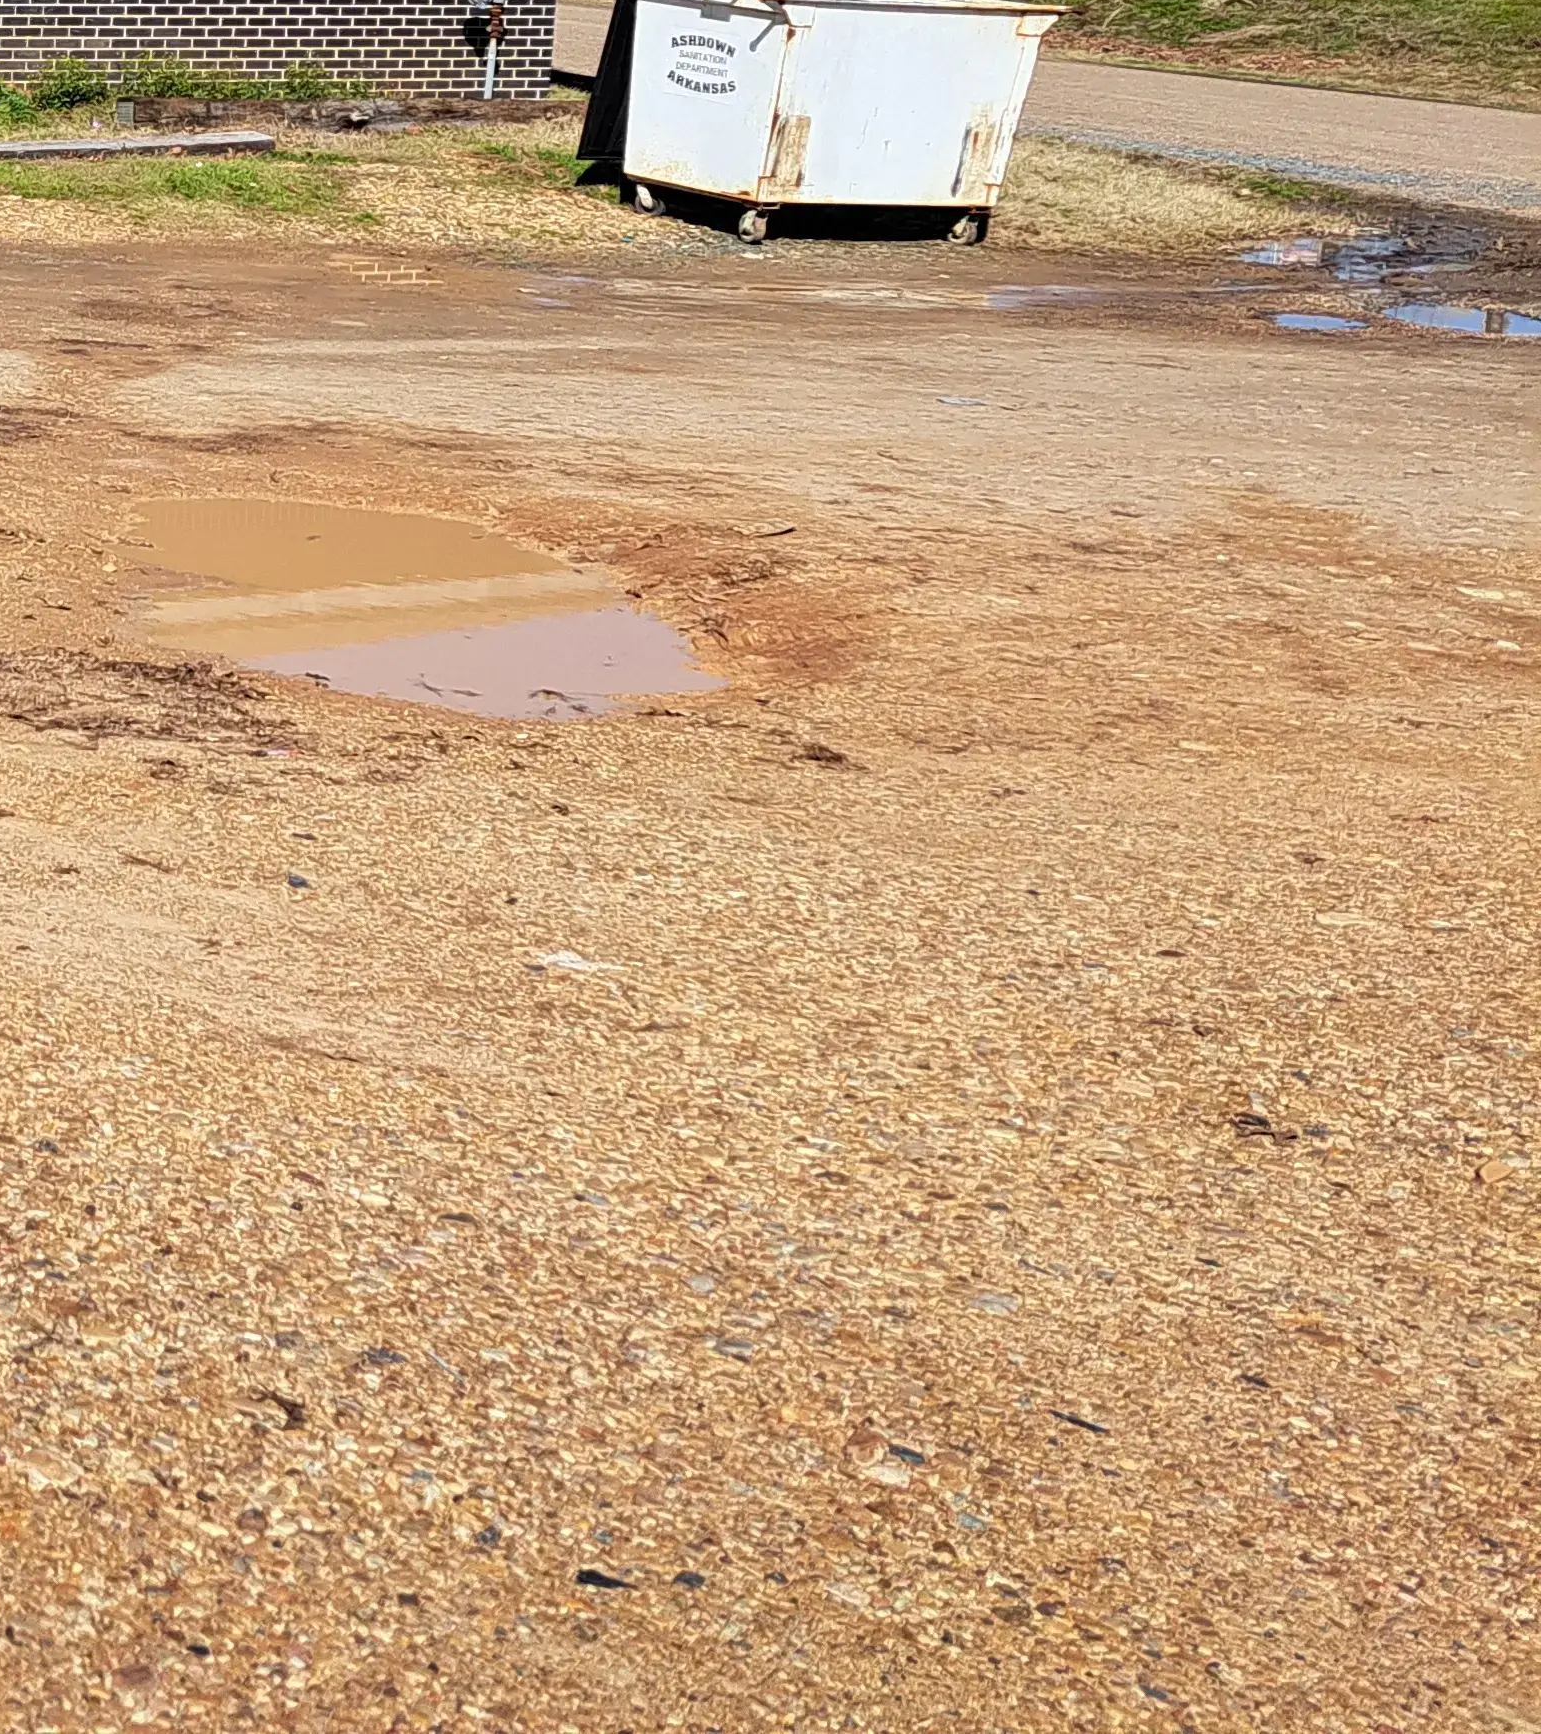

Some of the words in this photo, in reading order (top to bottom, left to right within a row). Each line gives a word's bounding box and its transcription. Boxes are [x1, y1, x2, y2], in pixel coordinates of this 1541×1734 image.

[670, 34, 737, 58] ASHDOWN
[679, 49, 728, 65] SANITATION
[675, 61, 729, 78] DEPARTMENT
[667, 69, 737, 95] ARKANSAS
